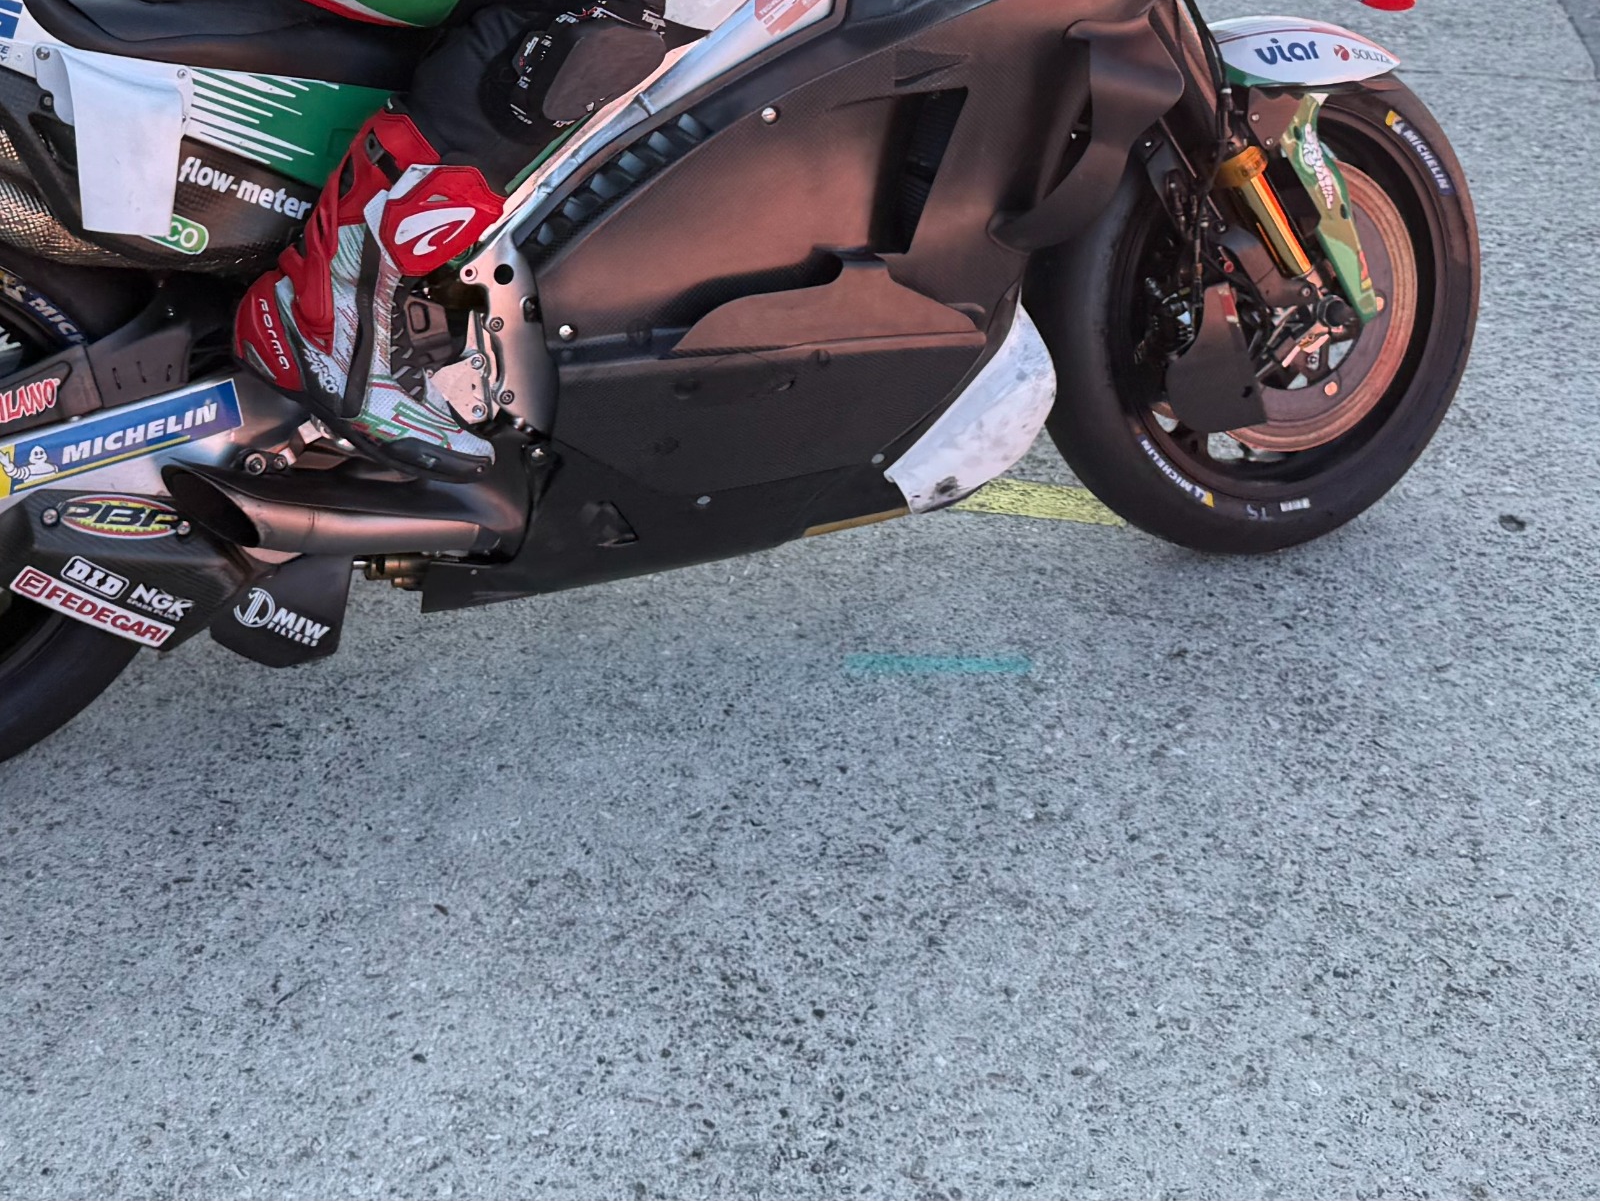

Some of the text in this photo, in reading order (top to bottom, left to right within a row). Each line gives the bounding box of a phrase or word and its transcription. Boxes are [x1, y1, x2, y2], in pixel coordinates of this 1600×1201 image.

[1254, 38, 1320, 65] viar
[1405, 128, 1450, 190] MICHELIN
[178, 157, 312, 220] flow-meter
[166, 221, 199, 248] CO
[61, 402, 218, 465] MICHELIN
[1141, 439, 1193, 492] MICHELIN
[46, 585, 168, 643] FEDEGARI
[131, 583, 195, 618] NGK
[267, 620, 319, 647] FILTERS
[272, 607, 330, 640] MIW
